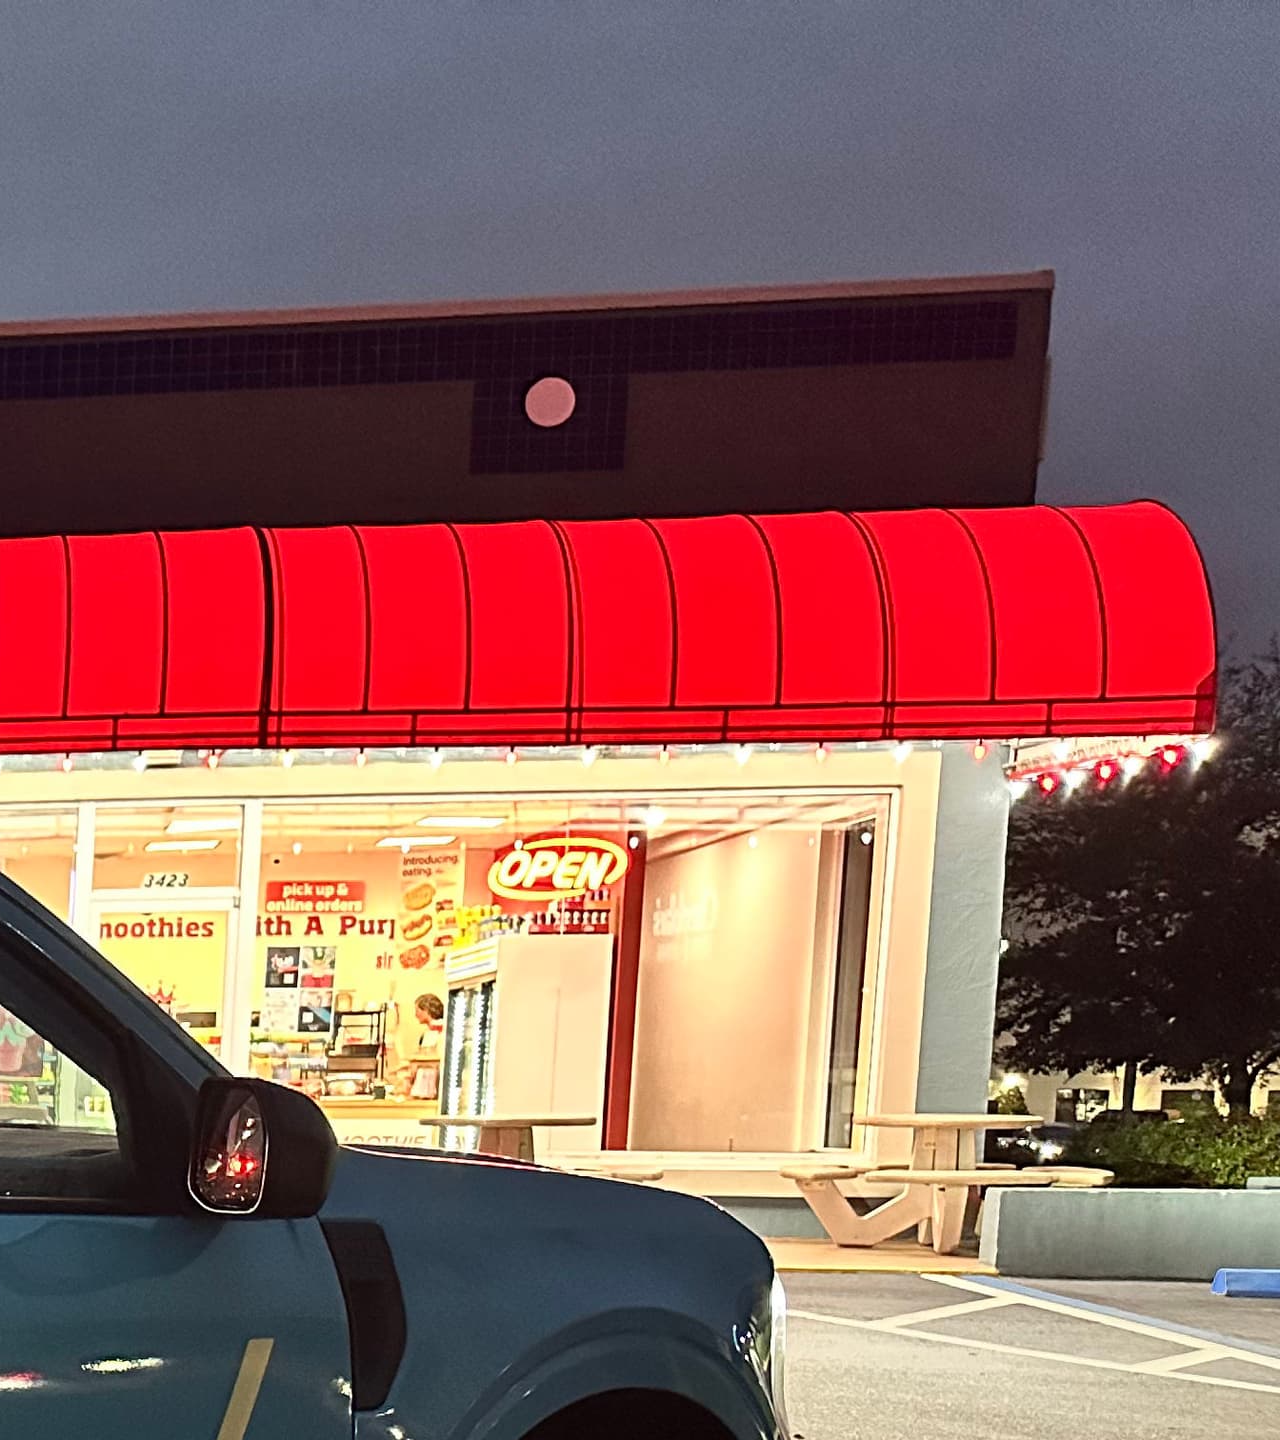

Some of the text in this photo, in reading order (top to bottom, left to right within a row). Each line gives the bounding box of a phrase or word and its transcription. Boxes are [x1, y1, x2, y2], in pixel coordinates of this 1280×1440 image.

[498, 850, 613, 889] OPEN
[144, 873, 189, 888] 3423
[282, 882, 313, 898] pick
[315, 884, 335, 898] up
[266, 898, 363, 912] online orders
[256, 915, 291, 937] ith
[304, 915, 324, 936] A
